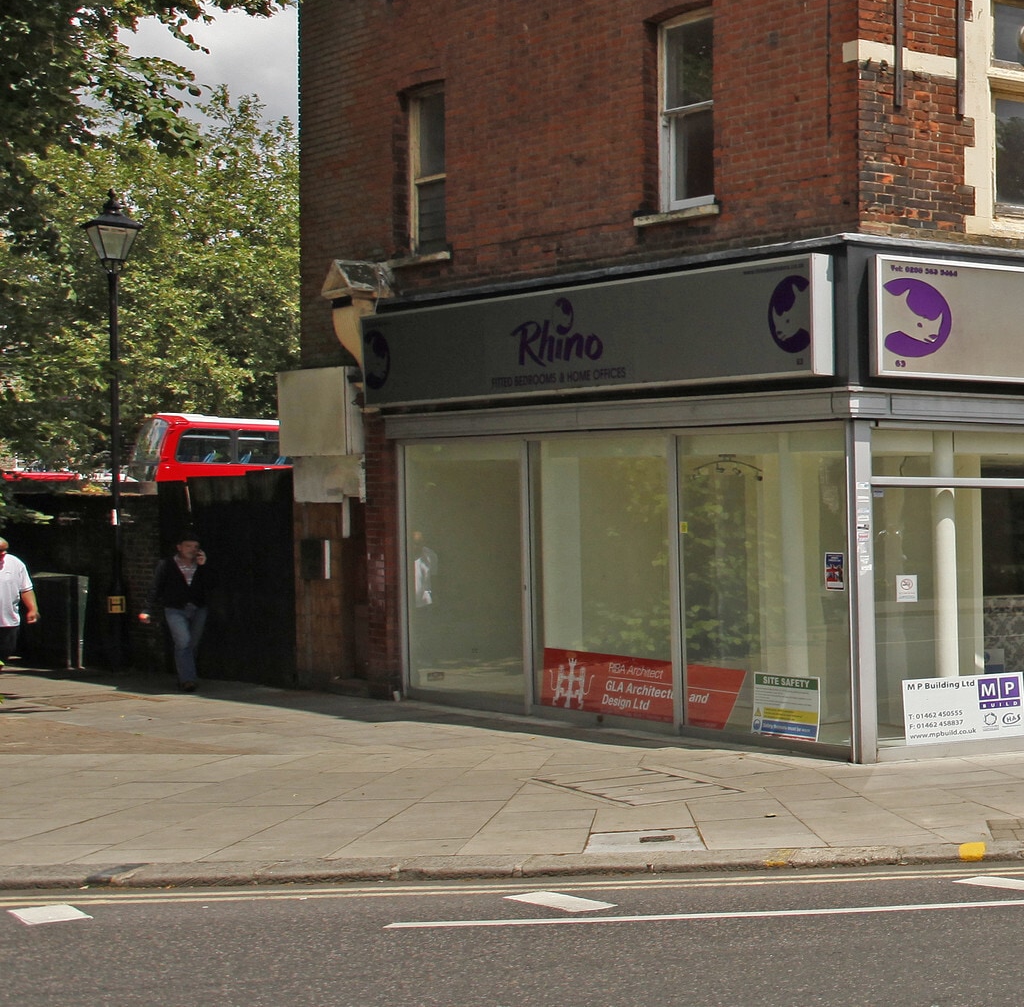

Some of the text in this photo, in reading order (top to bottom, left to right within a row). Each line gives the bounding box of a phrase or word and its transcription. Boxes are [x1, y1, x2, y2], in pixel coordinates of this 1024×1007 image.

[511, 297, 604, 368] Rhino
[895, 360, 906, 368] 63
[567, 370, 591, 382] HOME
[592, 367, 626, 380] OFFICES
[763, 676, 810, 688] SITE SAFETY
[925, 680, 960, 690] Building
[962, 679, 975, 687] Ltd
[605, 679, 624, 693] GLA
[689, 693, 709, 704] and
[601, 694, 650, 711] Design Ltd
[982, 701, 1018, 709] BUILD
[916, 711, 937, 720] 01462
[916, 721, 938, 729] 01462
[910, 728, 976, 739] www.mpbuild.co.uk
